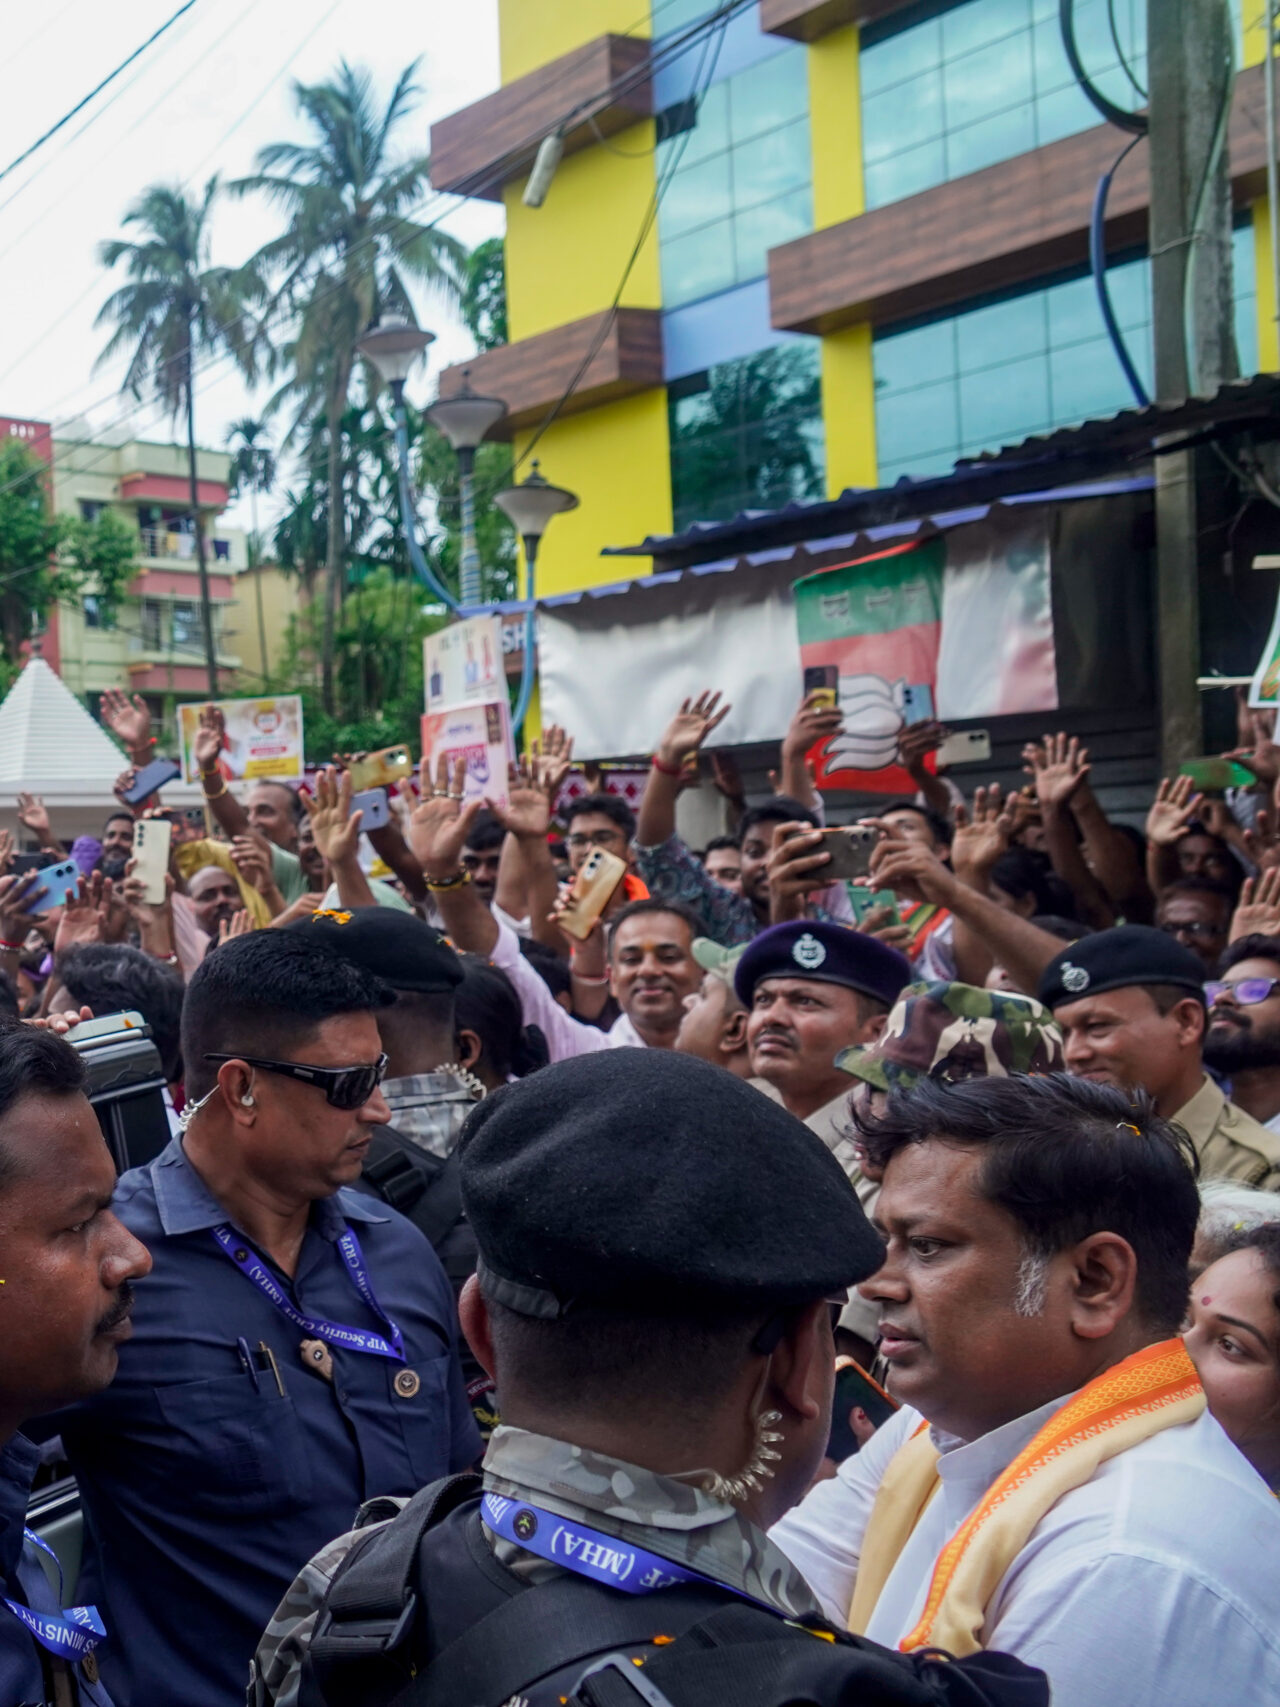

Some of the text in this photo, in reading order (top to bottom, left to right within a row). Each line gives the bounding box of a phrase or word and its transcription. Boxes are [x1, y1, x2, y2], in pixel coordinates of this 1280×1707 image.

[249, 1265, 283, 1305] (MHA)
[317, 1321, 365, 1347] Security
[367, 1339, 388, 1352] VIP
[550, 1525, 636, 1581] (MHA)
[21, 1608, 86, 1651] MINISTRY
